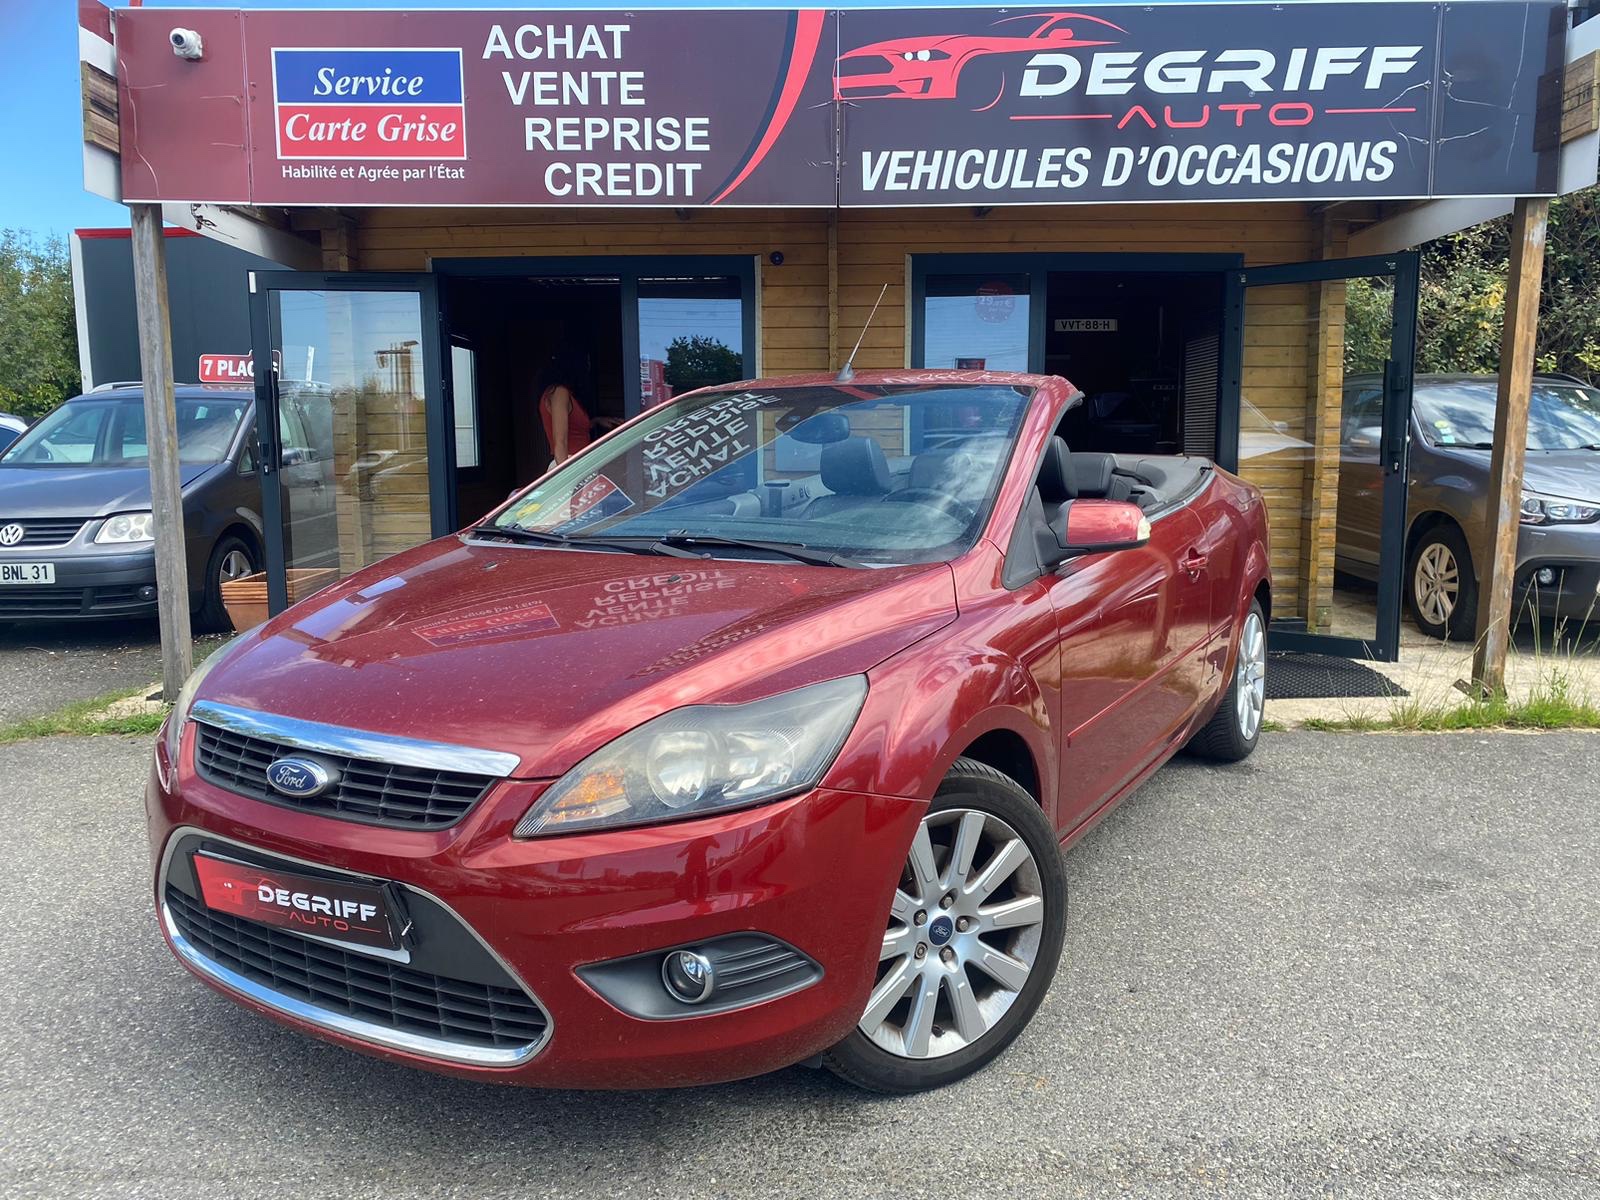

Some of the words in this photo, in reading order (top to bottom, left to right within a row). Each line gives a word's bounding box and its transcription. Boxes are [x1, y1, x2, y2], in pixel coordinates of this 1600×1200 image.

[482, 24, 631, 59] ACHAT
[313, 67, 424, 96] Service
[1019, 45, 1424, 97] DEGRIFF
[502, 71, 646, 105] VENTE
[285, 113, 367, 141] Carte
[377, 114, 457, 142] Grise
[1117, 102, 1314, 130] AUTO
[525, 117, 711, 151] REPRISE
[282, 165, 337, 179] Habilité
[340, 167, 354, 179] et
[358, 165, 399, 182] Agrée
[403, 168, 426, 182] par
[429, 163, 465, 179] l'État
[544, 162, 702, 197] CREDIT
[862, 147, 1092, 191] VEHICULES
[1102, 140, 1398, 187] D'OCCASIONS
[203, 360, 214, 376] 7
[217, 360, 279, 377] PLAC
[2, 565, 28, 580] BNL
[31, 565, 48, 580] 31
[275, 766, 307, 788] Ford
[258, 885, 377, 922] DEGRIFF
[289, 911, 350, 931] AUTO
